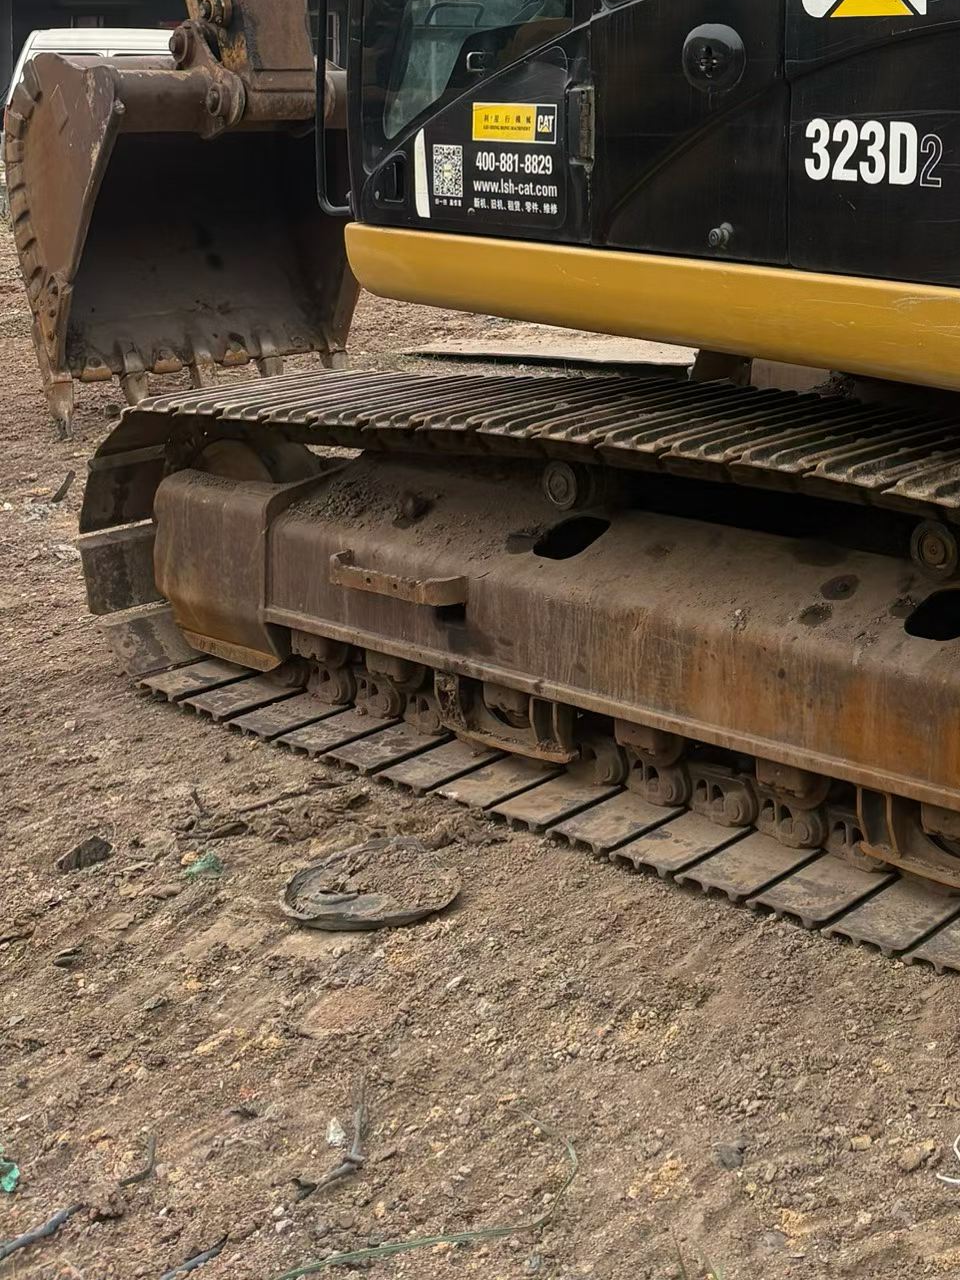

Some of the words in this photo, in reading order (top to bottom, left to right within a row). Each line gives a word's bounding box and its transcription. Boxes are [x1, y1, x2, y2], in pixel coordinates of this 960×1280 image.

[537, 114, 554, 133] CAT
[475, 151, 553, 175] 400-881-8829
[473, 178, 558, 198] www.lsh-cat.com
